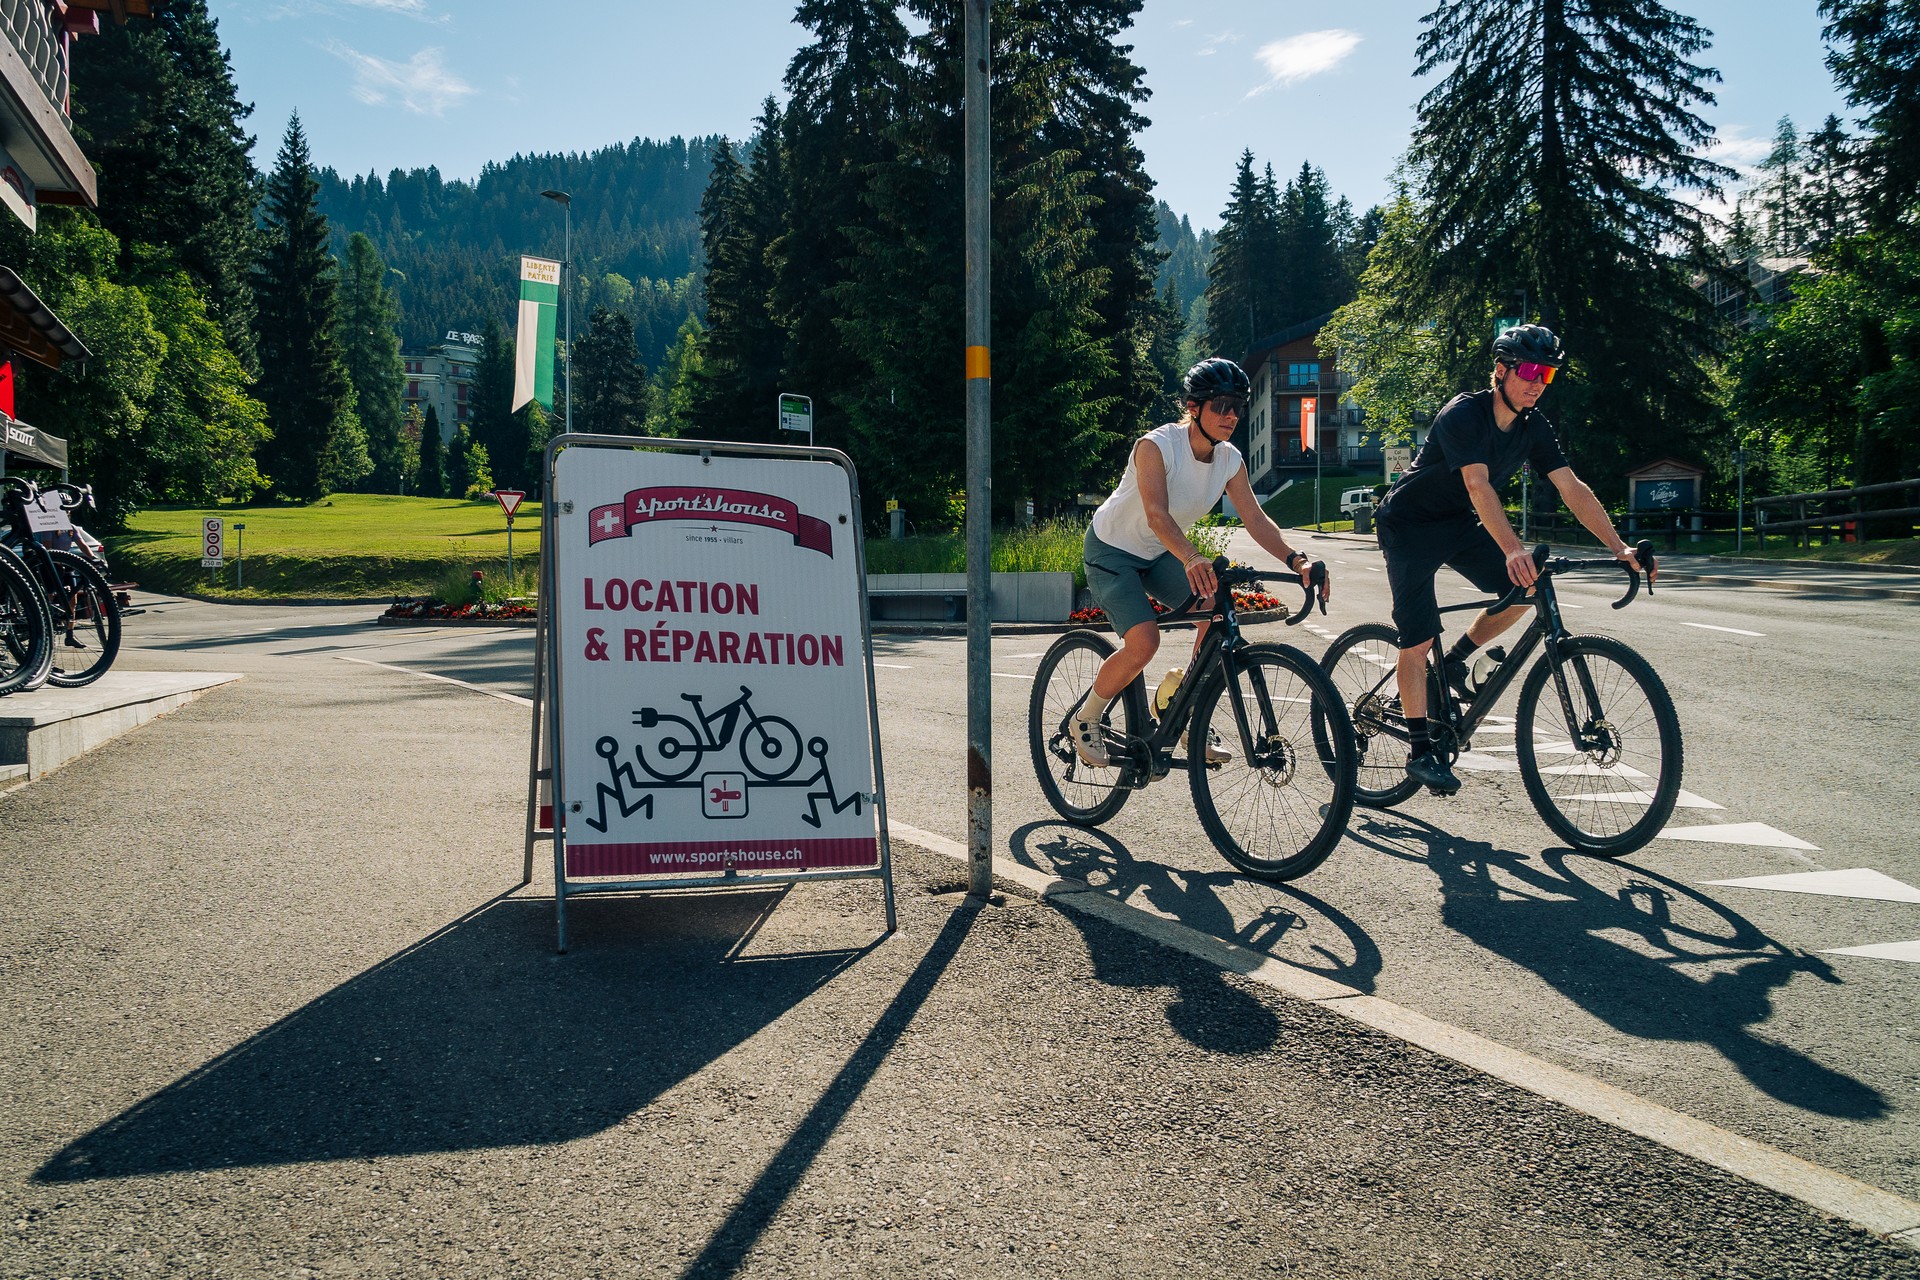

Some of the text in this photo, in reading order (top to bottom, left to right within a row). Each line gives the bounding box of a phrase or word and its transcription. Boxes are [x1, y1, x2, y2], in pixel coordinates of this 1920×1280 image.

[527, 272, 554, 282] PATRIE
[445, 330, 460, 341] LE
[9, 427, 35, 447] SCOTT
[635, 494, 788, 522] sport'shouse
[686, 534, 744, 545] since 1955 villars
[583, 577, 760, 616] LOCATION
[583, 620, 845, 667] & RÉPARATION
[650, 847, 803, 866] www.sportshouse.ch
